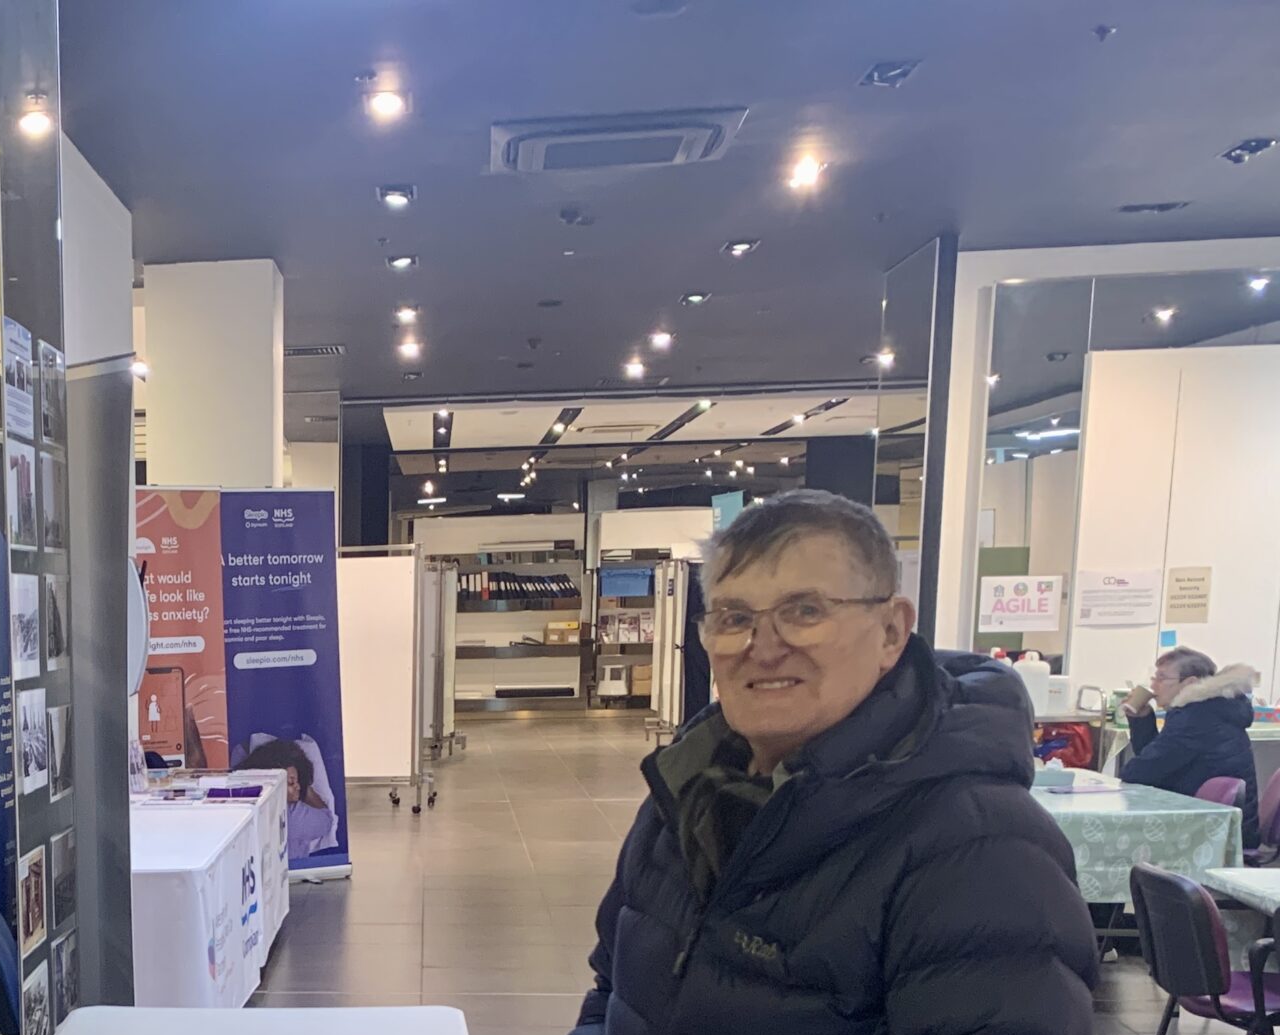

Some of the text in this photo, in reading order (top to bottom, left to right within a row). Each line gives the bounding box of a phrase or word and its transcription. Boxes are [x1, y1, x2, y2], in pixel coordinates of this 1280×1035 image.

[274, 508, 294, 518] NHS
[161, 536, 178, 545] NHS
[228, 553, 265, 567] better
[267, 553, 324, 565] tomorrow
[157, 570, 192, 584] would
[231, 571, 312, 588] starts tonight
[159, 590, 183, 603] look
[186, 589, 206, 602] like
[991, 597, 1049, 614] AGILE
[161, 607, 210, 623] anxiety?
